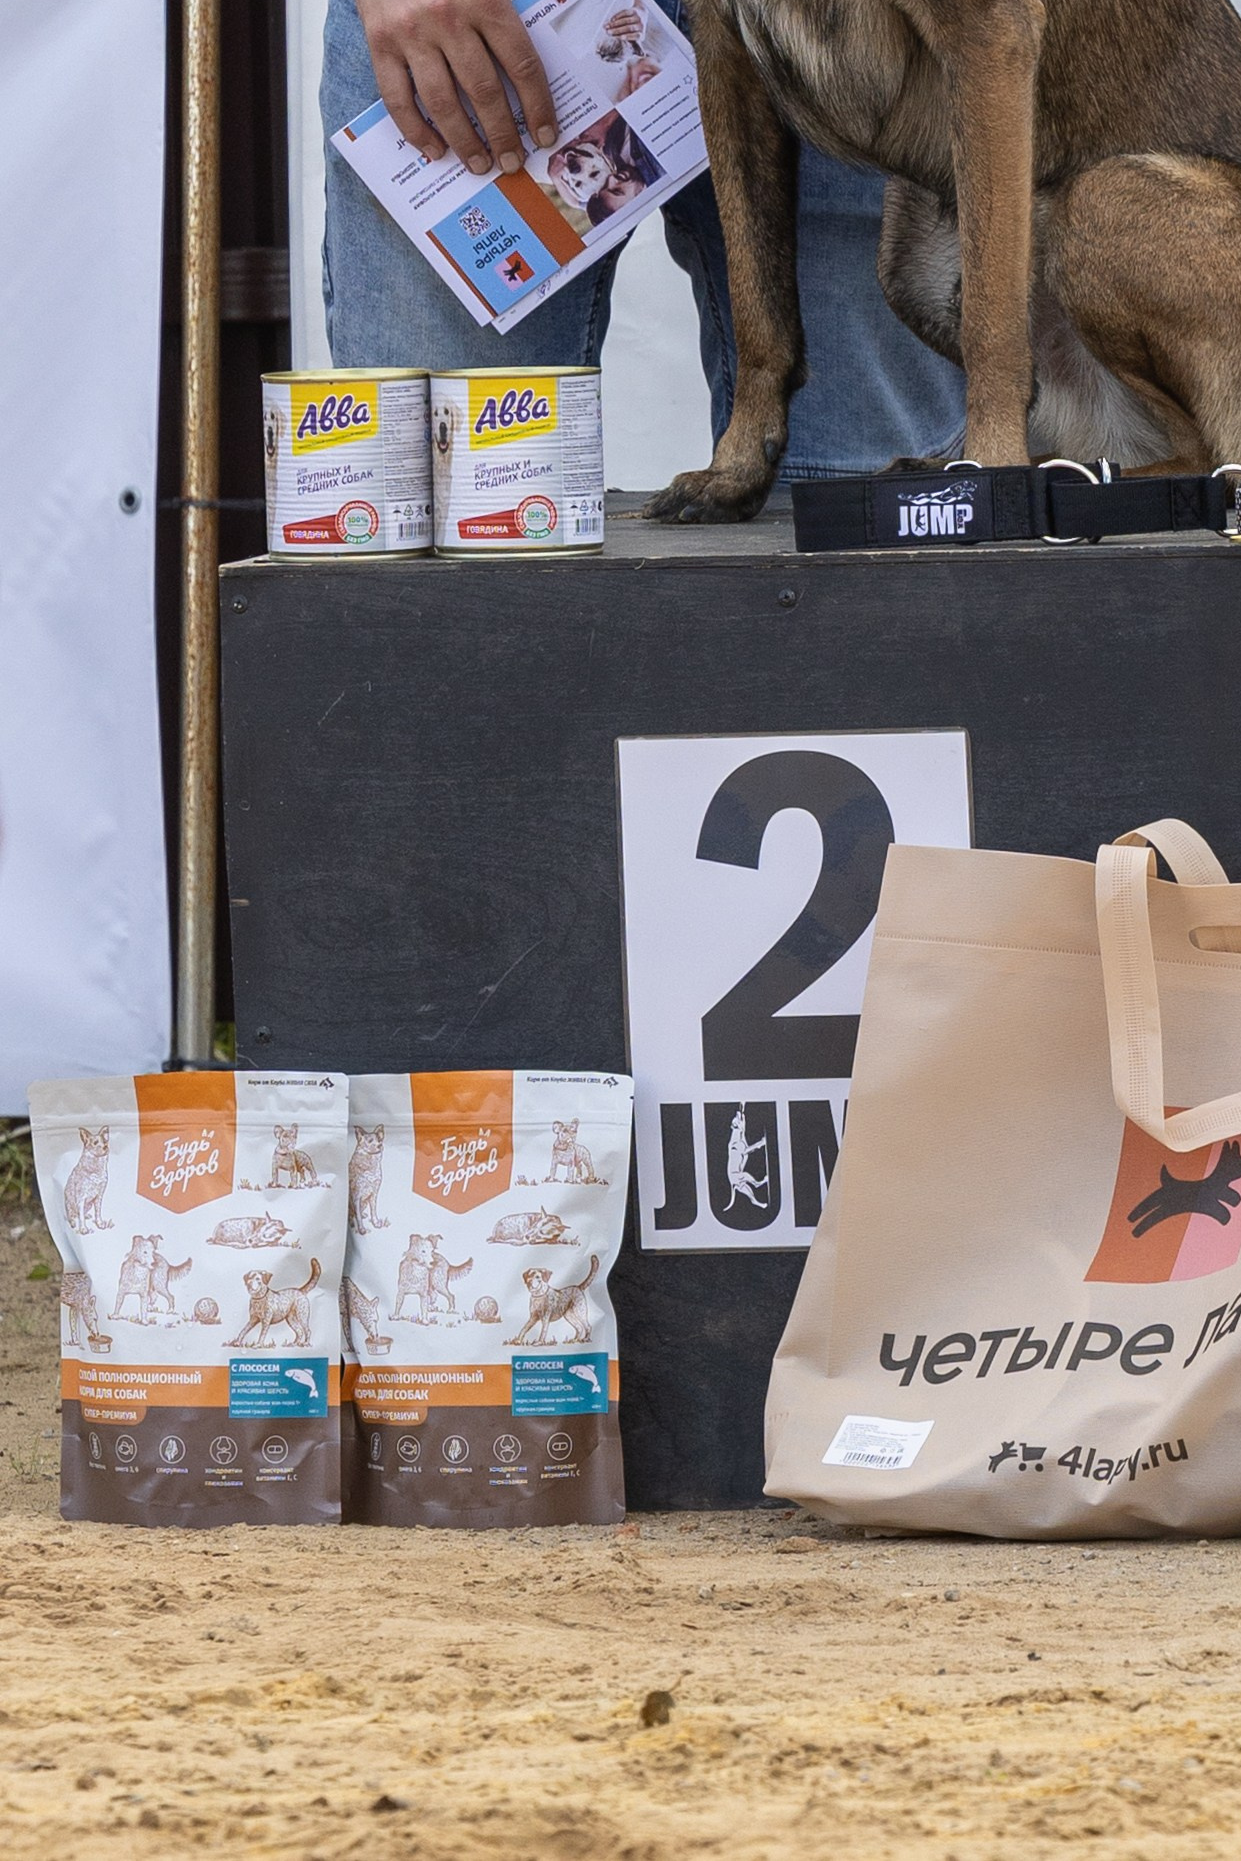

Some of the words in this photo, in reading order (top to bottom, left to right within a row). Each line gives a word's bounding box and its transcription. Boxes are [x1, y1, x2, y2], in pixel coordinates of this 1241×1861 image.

[898, 504, 974, 537] JUMP
[696, 749, 895, 1082] 2
[163, 1135, 210, 1167] Будь
[440, 1135, 489, 1167] Будь
[150, 1148, 220, 1197] Здоров
[427, 1147, 499, 1196] Здоров
[238, 1363, 280, 1373] ЛОСОСЕМ
[522, 1360, 564, 1370] ЛОСОСЕМ
[114, 1389, 148, 1400] СОБАК
[393, 1389, 429, 1401] СОБАК
[1057, 1438, 1189, 1485] 4lapy.ru
